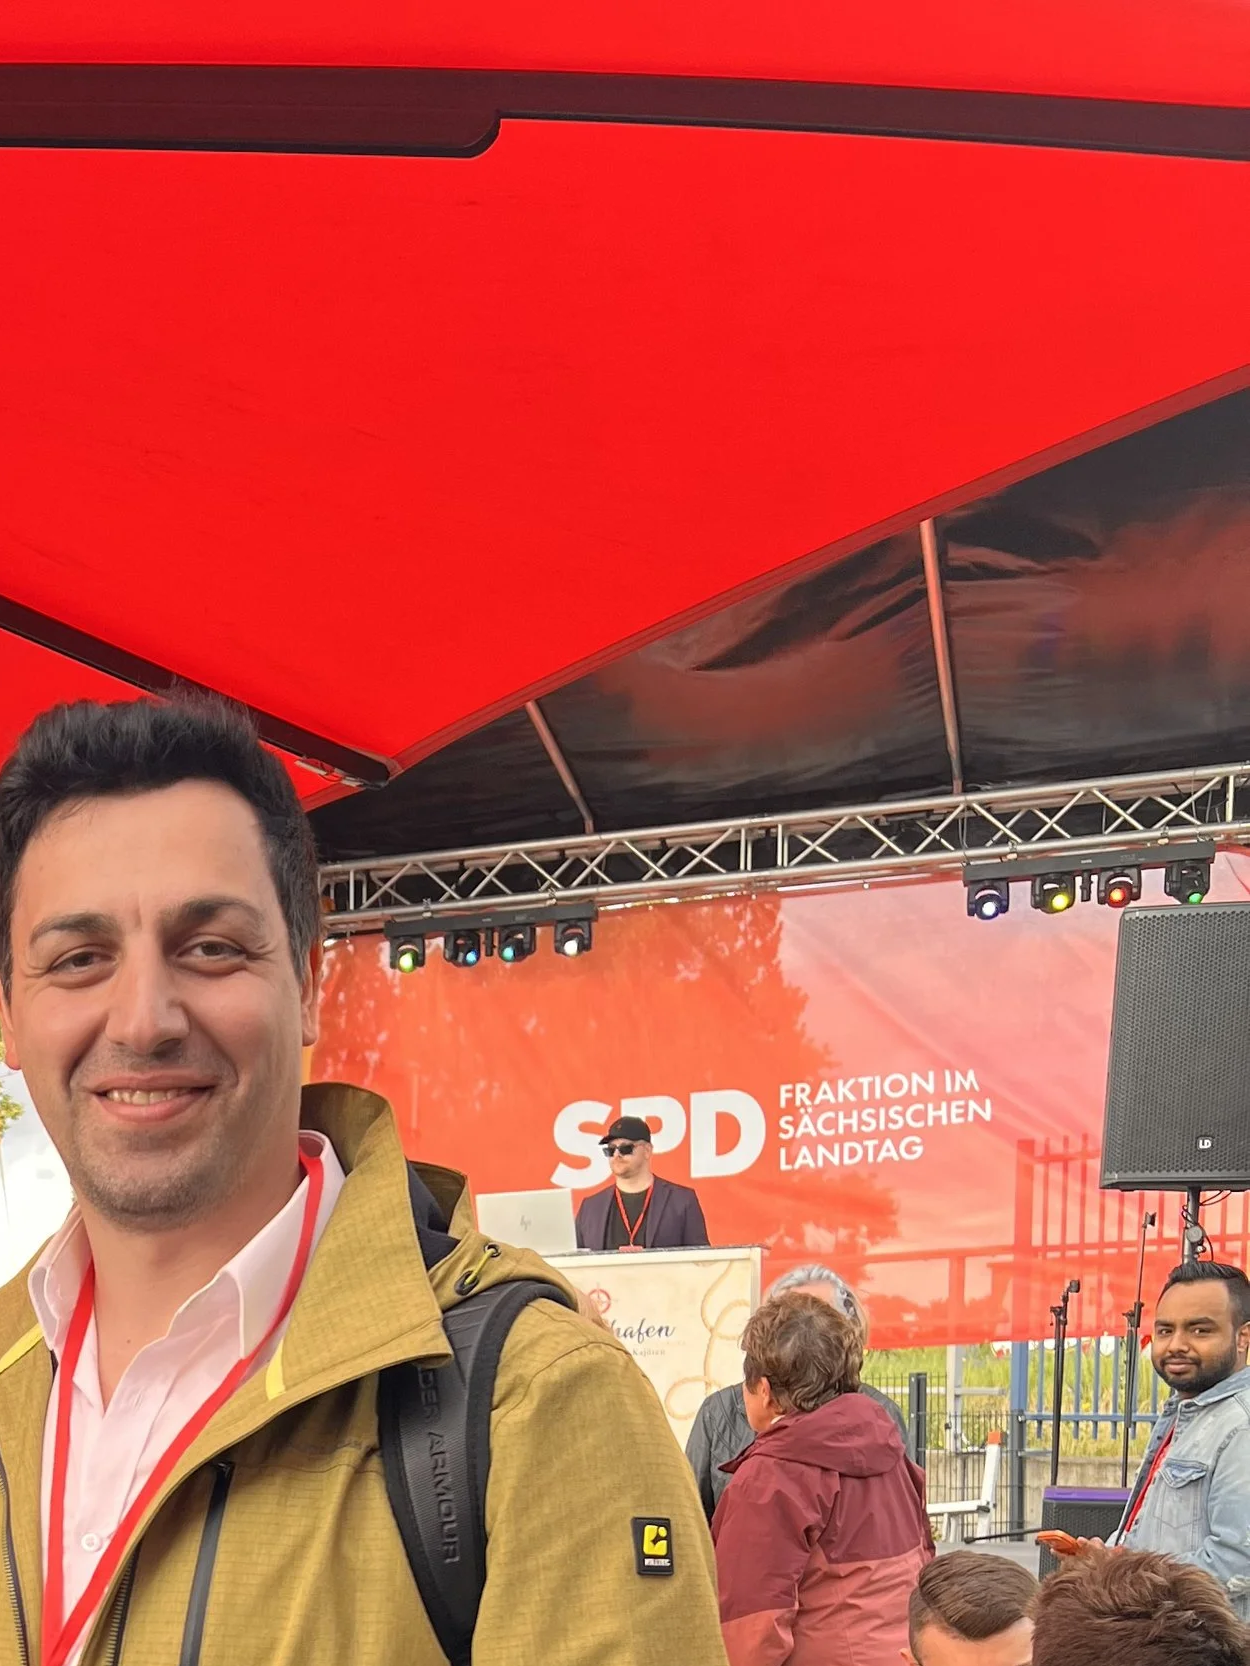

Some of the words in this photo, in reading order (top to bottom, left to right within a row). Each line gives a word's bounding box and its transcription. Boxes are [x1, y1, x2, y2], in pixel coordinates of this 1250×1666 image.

[778, 1070, 935, 1108] FRAKTION
[944, 1068, 980, 1092] IM
[550, 1088, 766, 1189] SPD
[778, 1098, 992, 1140] SÄCHSISCHEN
[778, 1136, 924, 1172] LANDTAG
[1198, 1139, 1212, 1149] LD
[427, 1431, 460, 1564] ARMOUR
